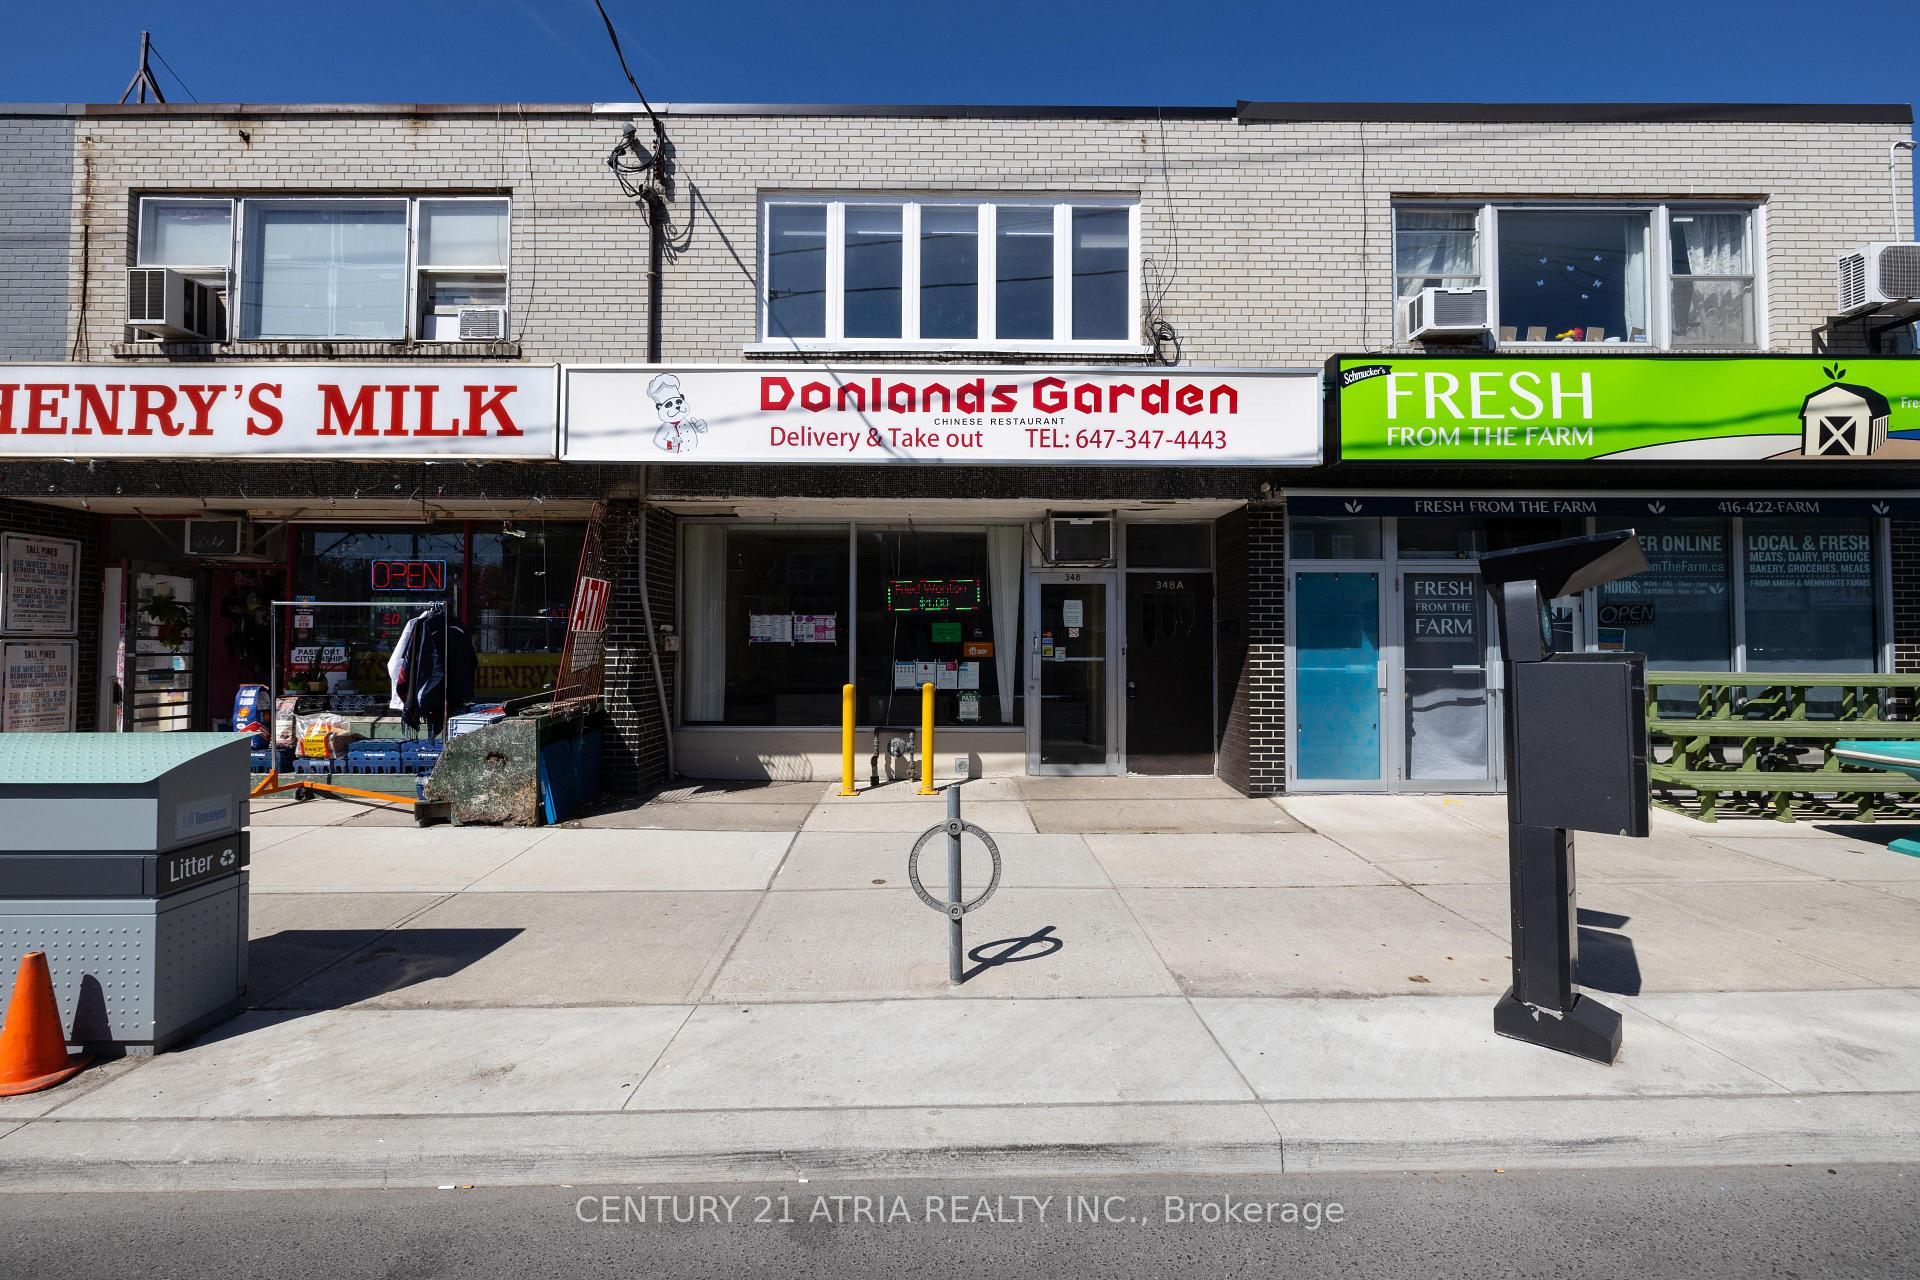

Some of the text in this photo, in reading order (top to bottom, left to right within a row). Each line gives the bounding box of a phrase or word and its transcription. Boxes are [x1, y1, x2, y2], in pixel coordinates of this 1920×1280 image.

[1343, 367, 1386, 385] Schmucker's
[760, 376, 1238, 415] Donlands Garden
[1386, 371, 1593, 420] FRESH
[317, 383, 524, 437] MILK
[934, 417, 1065, 426] CHINESE RESTAURANT
[770, 426, 984, 451] Delivery & Take out
[1025, 428, 1227, 449] TEL: 647-347-4443
[1387, 427, 1594, 447] FROM THE FARM
[1415, 500, 1597, 513] FRESH FROM THE FARM
[1718, 501, 1820, 514] 416-422-FARM
[1665, 535, 1723, 552] ONLINE
[1749, 535, 1870, 551] LOCAL & FRESH
[1750, 551, 1870, 563] MEATS, DAIRY, PRODUCE
[373, 561, 442, 589] OPEN
[1750, 563, 1870, 574] BAKERY, GROCERIES, MEALS
[1065, 573, 1081, 582] 348
[1155, 580, 1184, 590] 348A
[1750, 579, 1771, 588] FROM
[1772, 579, 1796, 588] AMISH
[1846, 579, 1871, 588] FARMS
[1414, 580, 1473, 596] FRESH
[1604, 581, 1641, 595] HOURS:
[1415, 602, 1472, 612] FROM THE
[1600, 605, 1656, 625] OPEN
[1415, 618, 1472, 635] FARM
[170, 854, 214, 883] Litter
